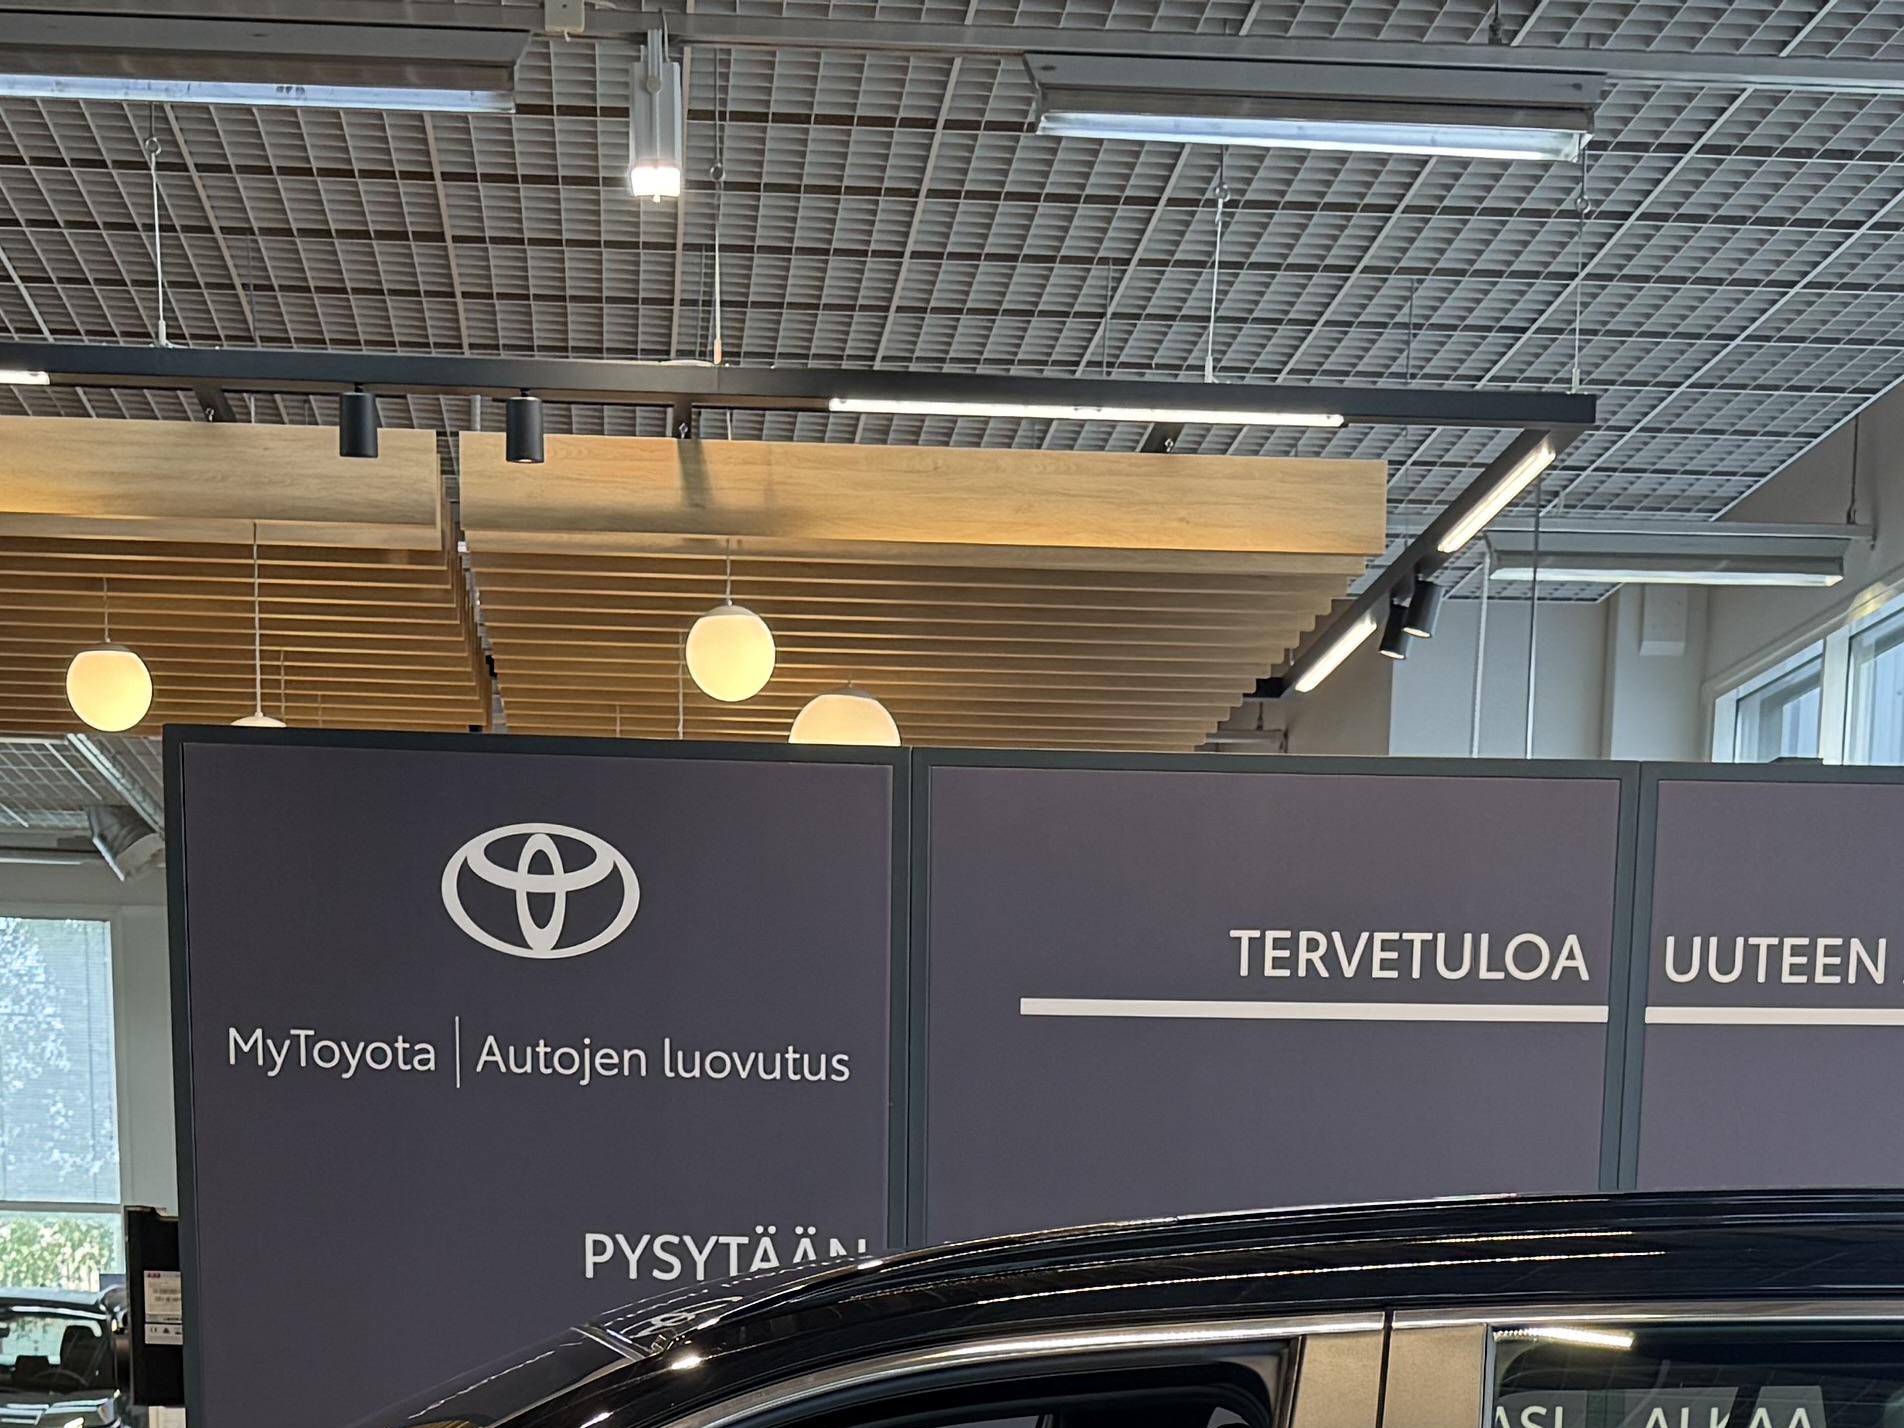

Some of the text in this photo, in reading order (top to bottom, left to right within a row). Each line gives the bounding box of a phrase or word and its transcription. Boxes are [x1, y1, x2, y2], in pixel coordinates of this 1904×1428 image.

[1230, 929, 1590, 982] TERVETULOA
[1665, 936, 1887, 985] UUTEEN
[229, 1027, 850, 1086] MyToyota Autojen luovutus
